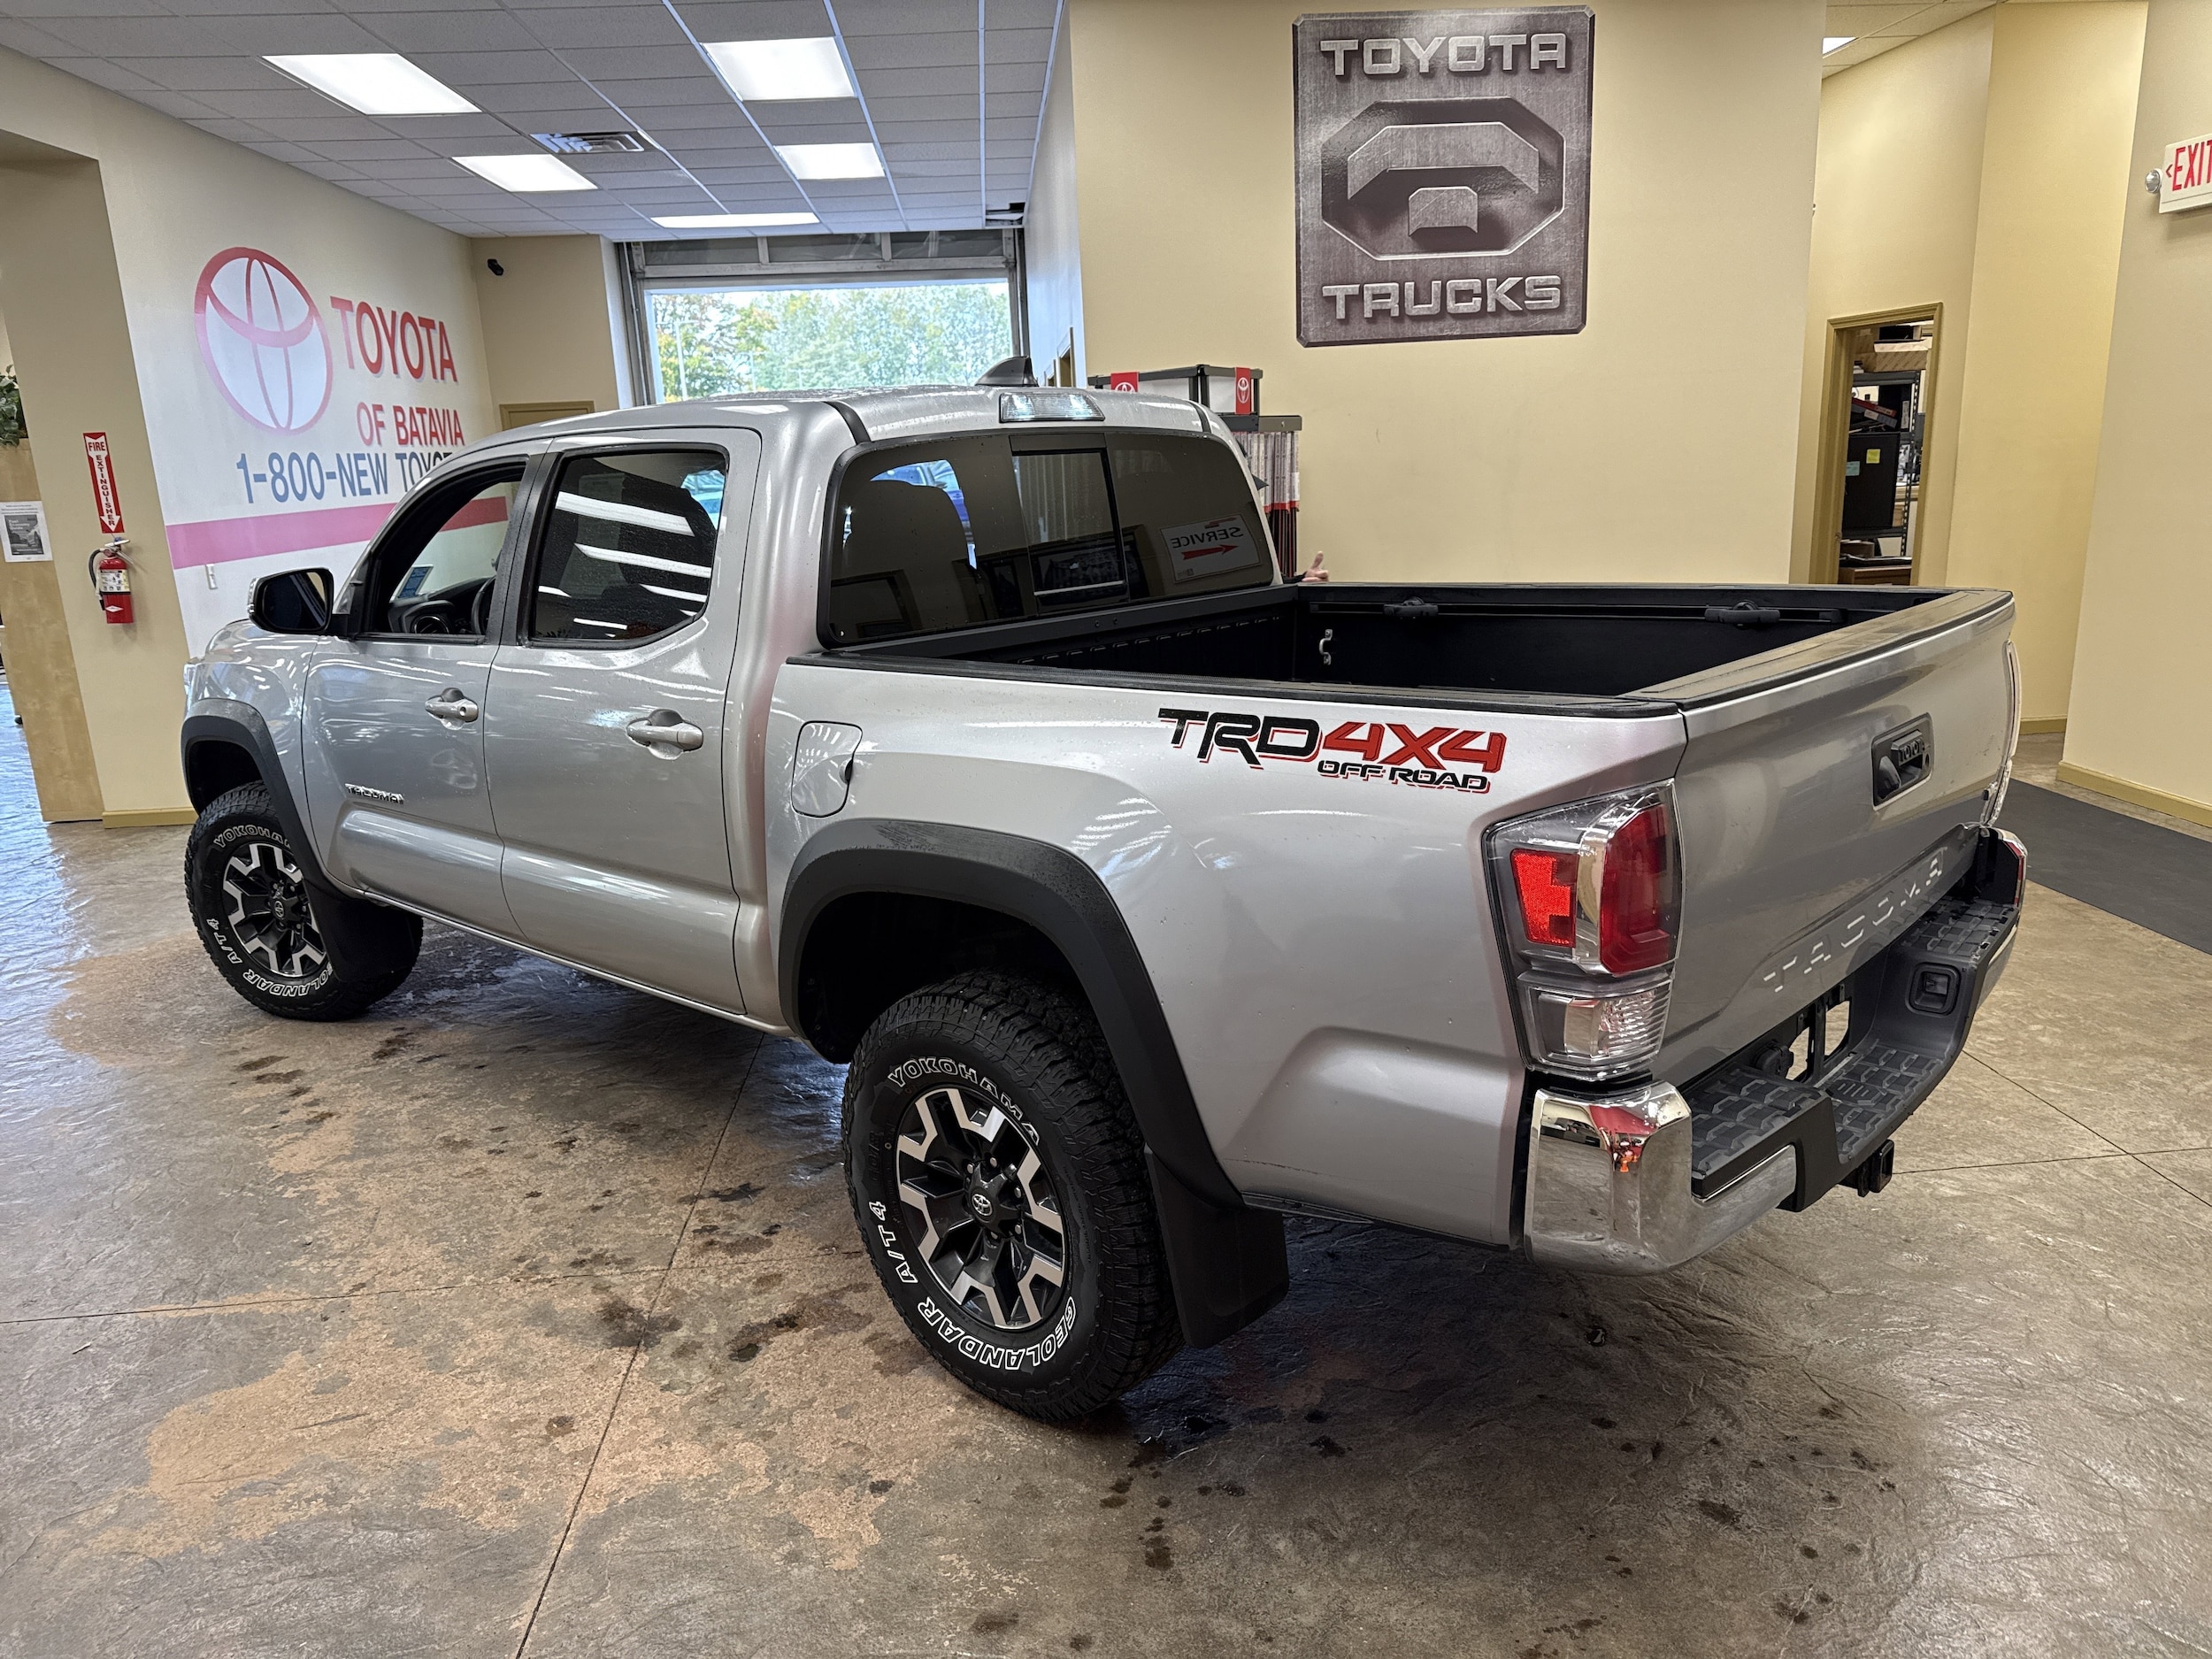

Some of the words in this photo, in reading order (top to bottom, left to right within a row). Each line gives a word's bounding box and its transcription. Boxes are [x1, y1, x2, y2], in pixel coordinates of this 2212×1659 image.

[1320, 33, 1567, 76] TOYOTA
[1322, 275, 1563, 319] TRUCKS
[330, 296, 458, 382] TOYOTA
[357, 402, 386, 446] OF
[393, 405, 465, 446] BATAVIA
[88, 442, 106, 452] FIRE
[96, 455, 115, 526] EXTINGUISHER
[236, 451, 388, 503] 1-800-NEW
[395, 451, 453, 493] TOY
[1158, 708, 1323, 770] TRD
[1323, 720, 1508, 773] 4X4
[344, 783, 405, 805] TACOMA
[1317, 759, 1386, 782] OFF
[1387, 767, 1492, 794] ROAD
[887, 1056, 1041, 1146] YOKOHAMA
[868, 1200, 887, 1221] 4
[918, 1295, 1077, 1371] GEOLANDAR
